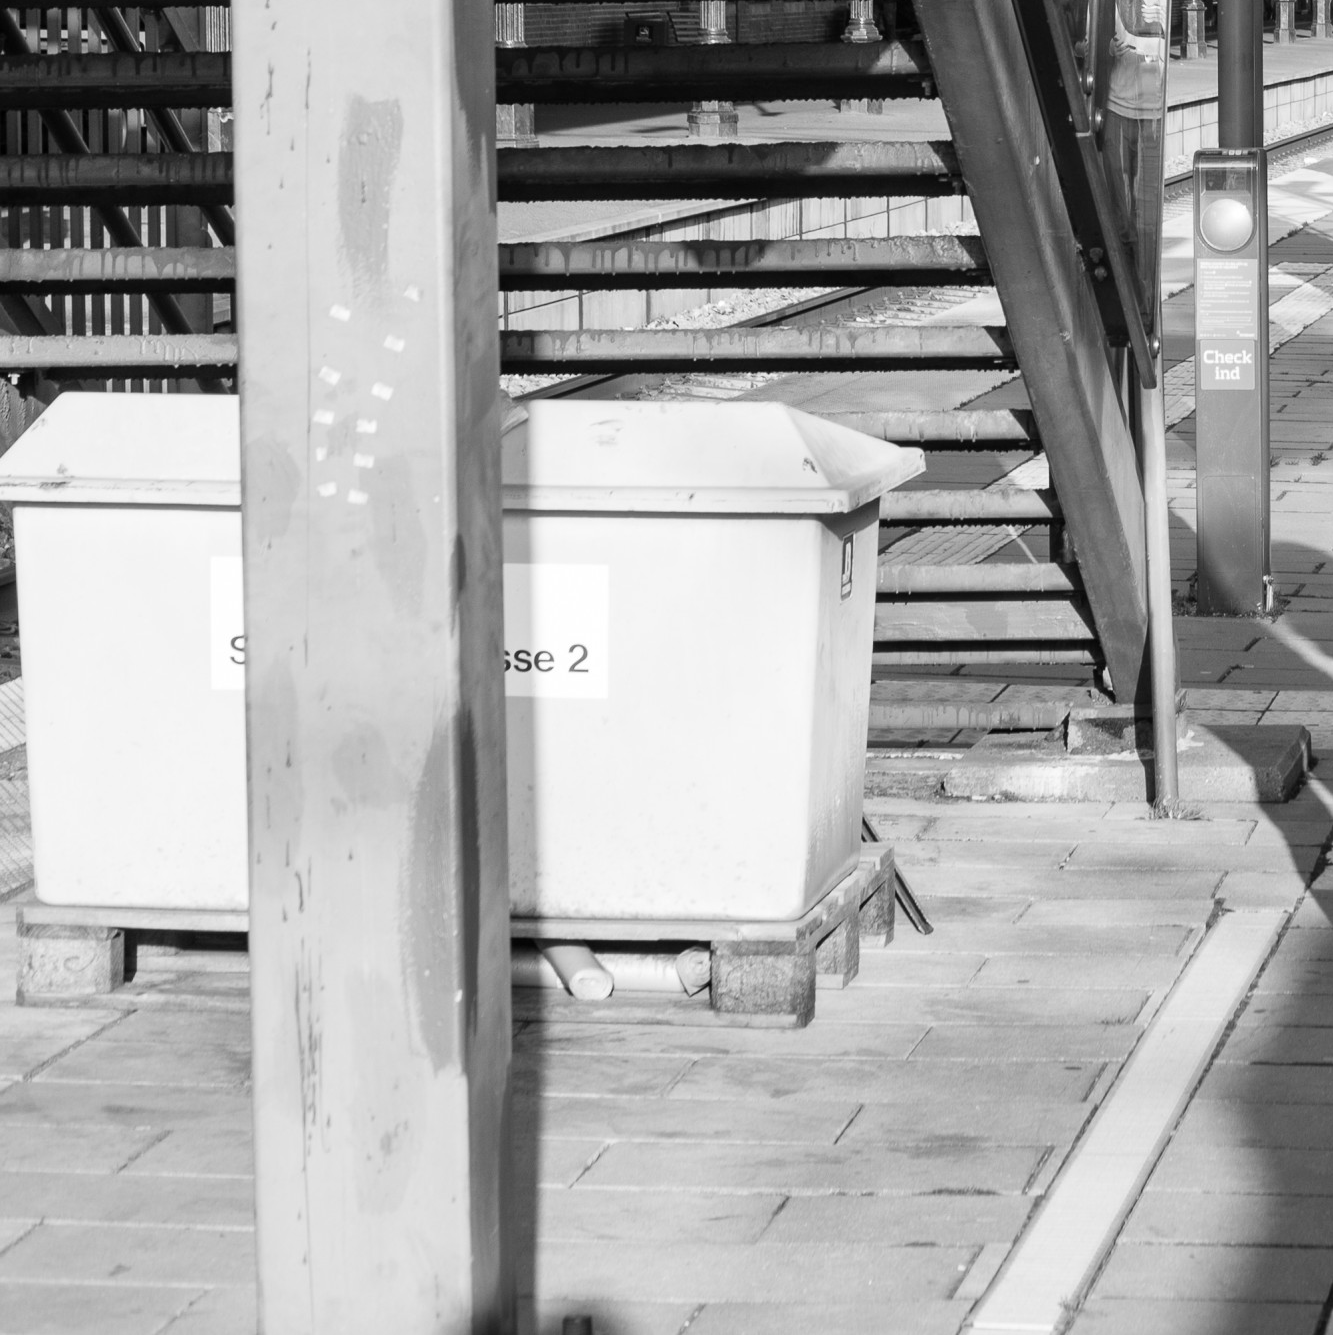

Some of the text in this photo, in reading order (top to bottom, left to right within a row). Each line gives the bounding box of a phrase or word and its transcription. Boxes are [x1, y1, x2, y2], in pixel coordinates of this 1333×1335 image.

[1203, 350, 1252, 364] Check
[1215, 366, 1240, 380] ind
[568, 644, 589, 672] 2
